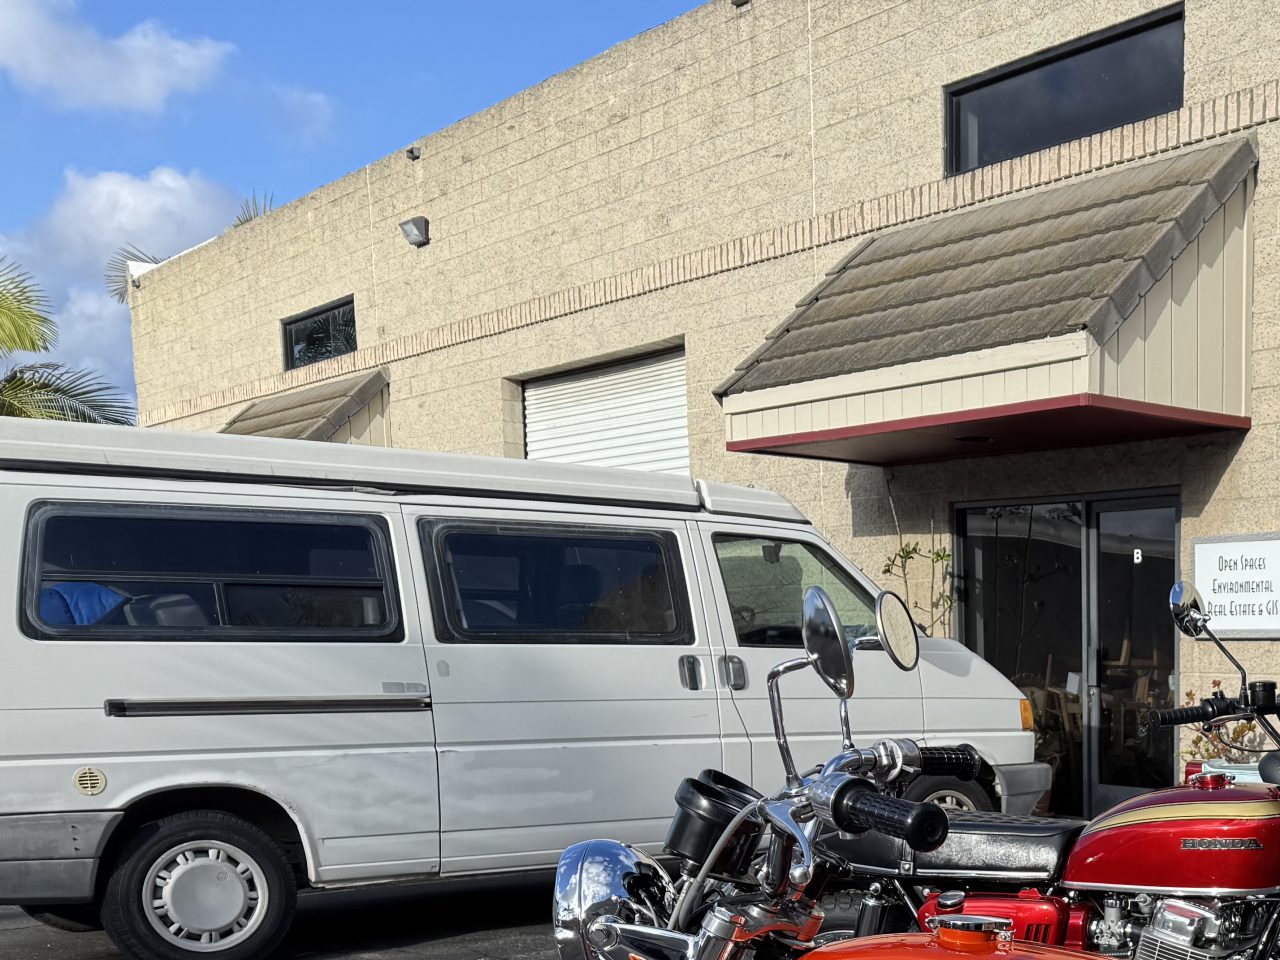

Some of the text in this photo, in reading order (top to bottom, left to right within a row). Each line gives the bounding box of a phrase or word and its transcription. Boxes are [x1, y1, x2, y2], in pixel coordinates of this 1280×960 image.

[1133, 549, 1142, 564] B
[1265, 599, 1279, 616] GIS
[1181, 837, 1264, 850] HONDA
